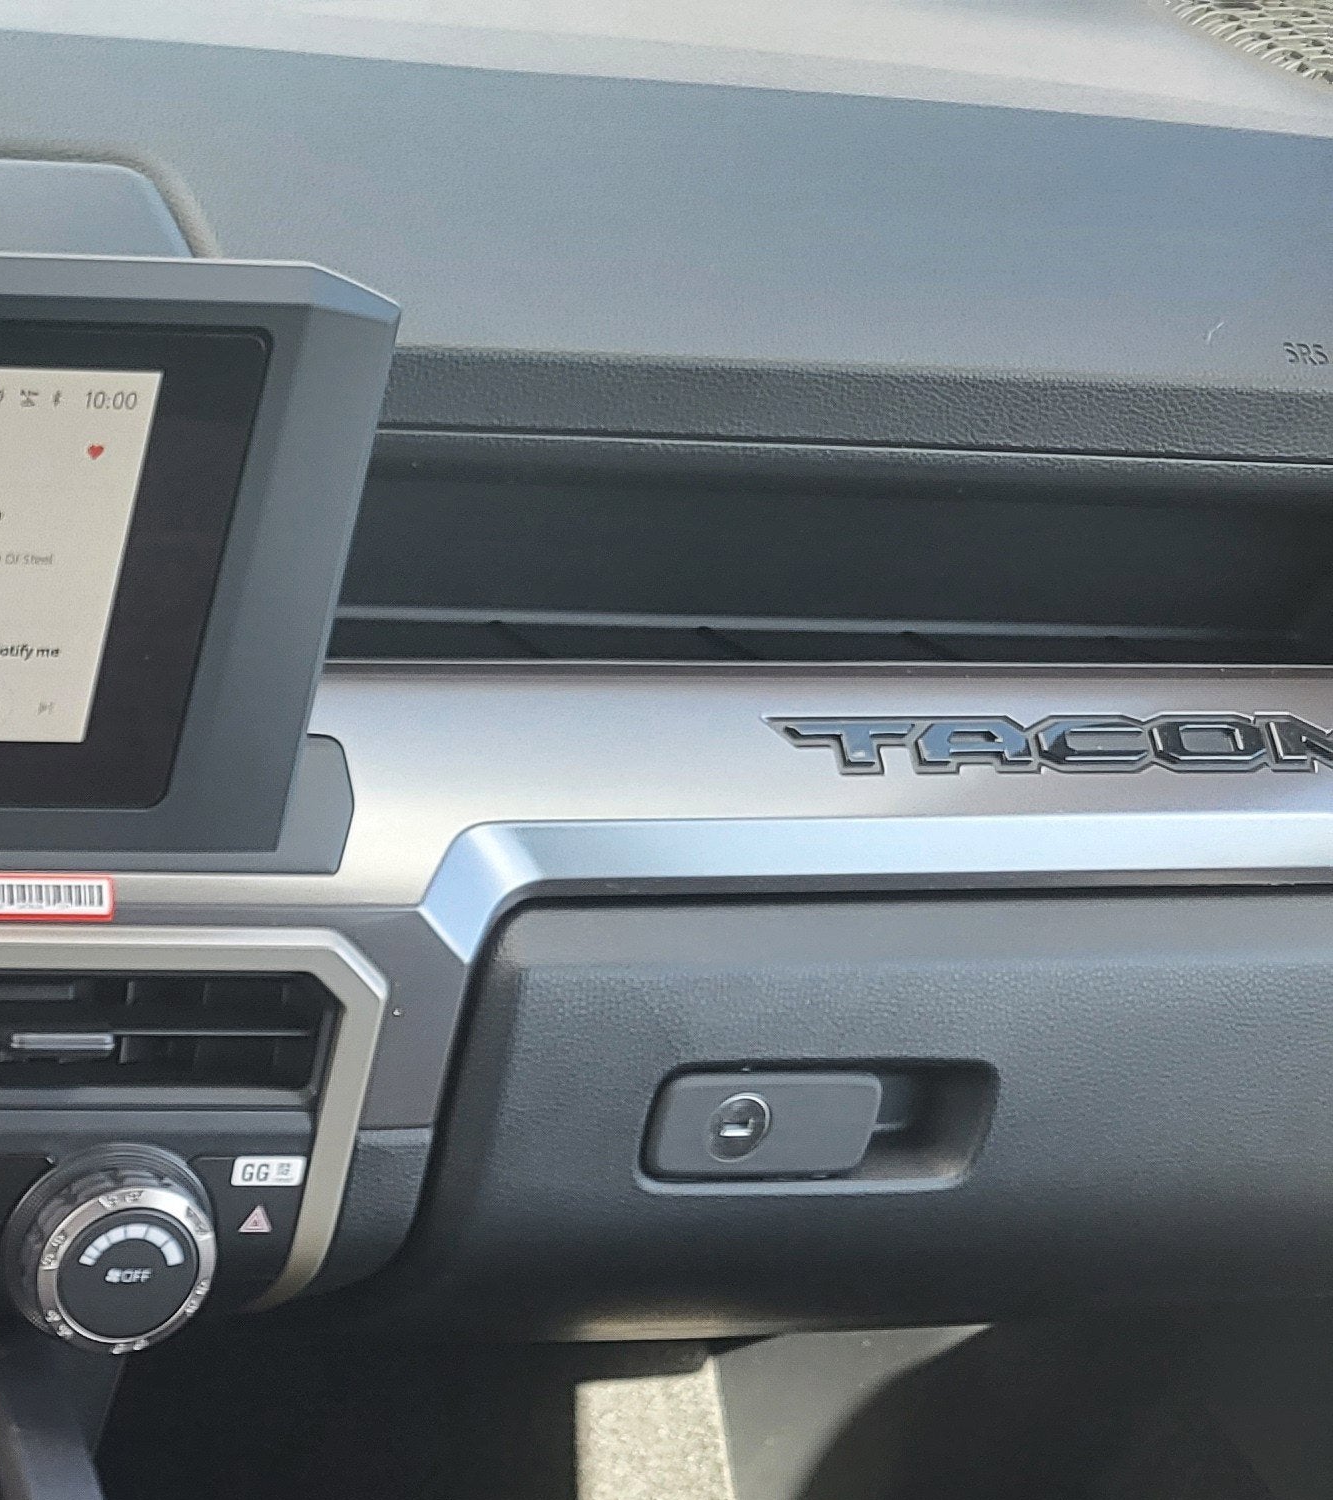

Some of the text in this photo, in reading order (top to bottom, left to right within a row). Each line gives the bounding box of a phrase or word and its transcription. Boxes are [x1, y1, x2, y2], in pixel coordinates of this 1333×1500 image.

[1282, 341, 1330, 367] SRS
[85, 389, 139, 412] 10:00
[36, 646, 61, 659] me
[241, 1163, 270, 1182] GG
[121, 1267, 153, 1284] OFF
